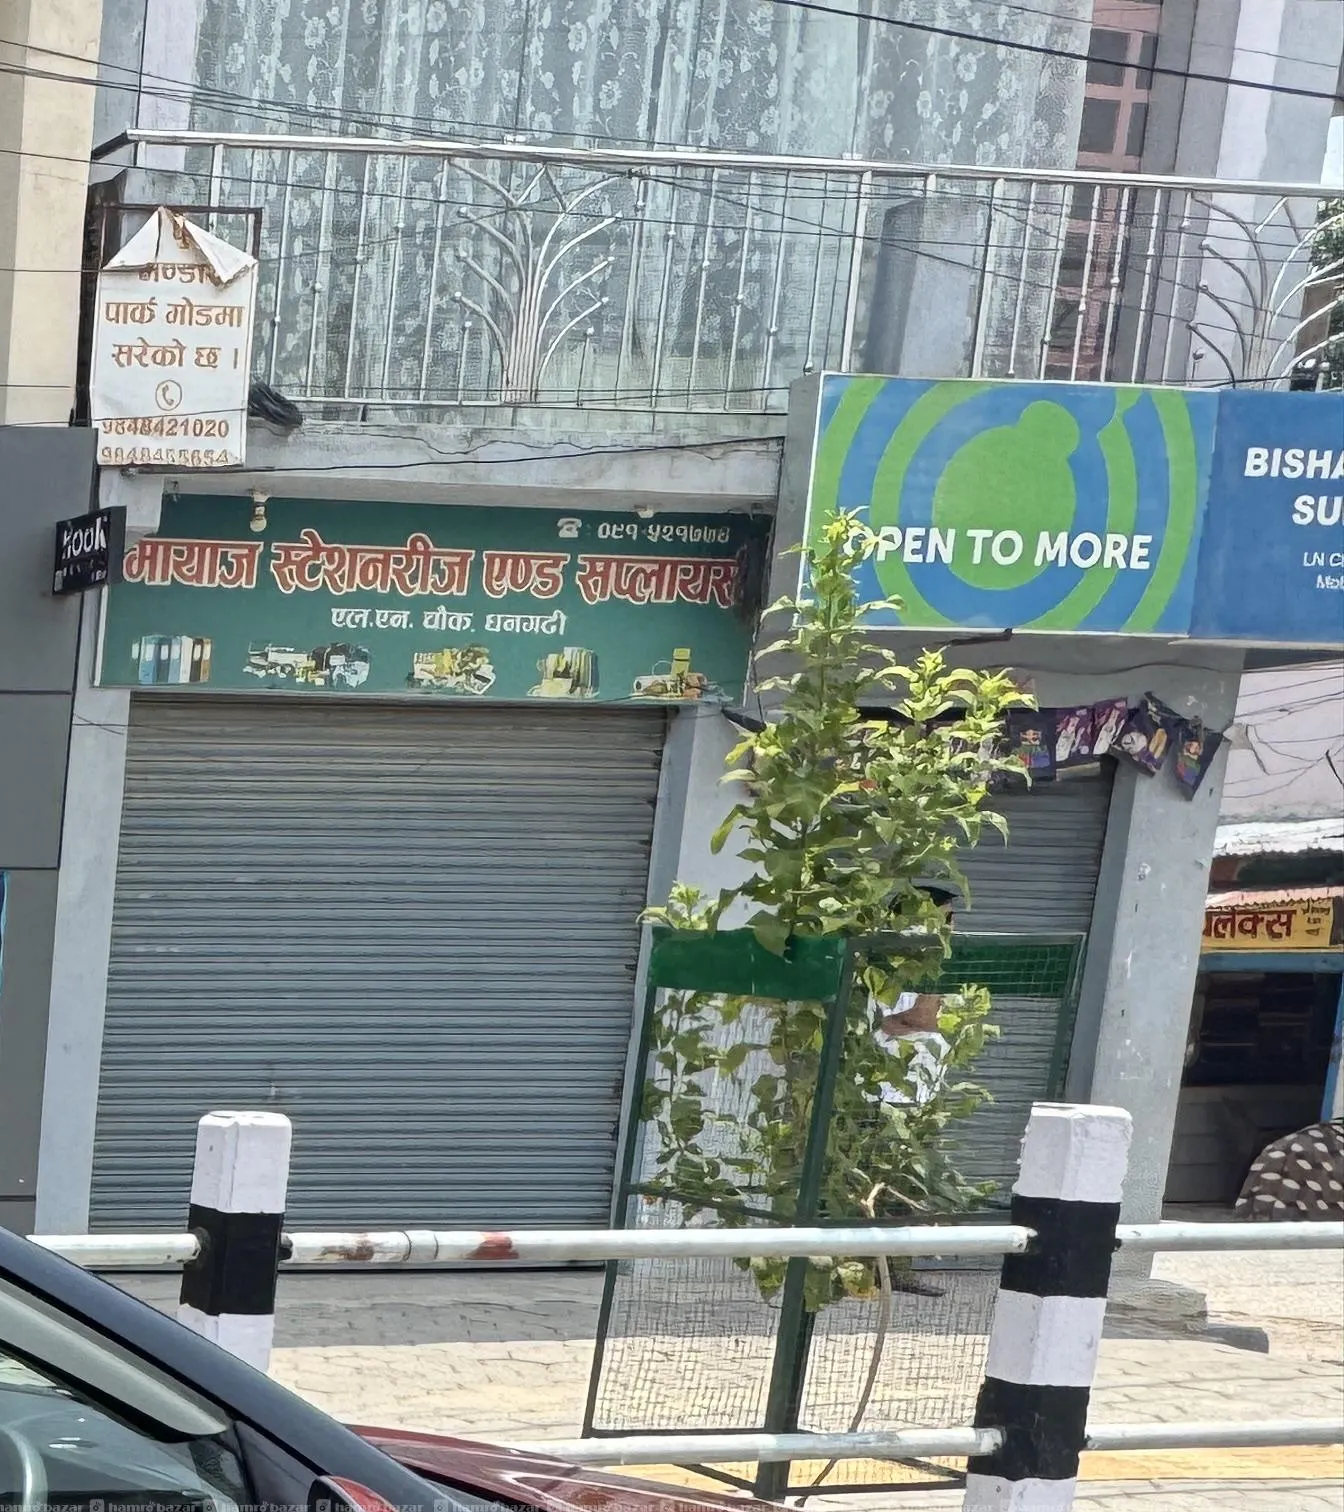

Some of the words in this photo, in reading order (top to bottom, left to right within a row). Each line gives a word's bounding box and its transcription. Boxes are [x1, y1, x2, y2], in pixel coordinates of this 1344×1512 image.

[105, 297, 158, 324] पार्क
[112, 337, 187, 368] सरेको
[1292, 495, 1344, 526] SU
[843, 525, 956, 564] OPEN
[967, 529, 1023, 565] TO
[1034, 531, 1153, 570] MORE
[1329, 552, 1344, 567] C
[123, 537, 263, 588] मायाज
[270, 528, 476, 596] स्टेशनरीज
[483, 550, 570, 599] एण्ड
